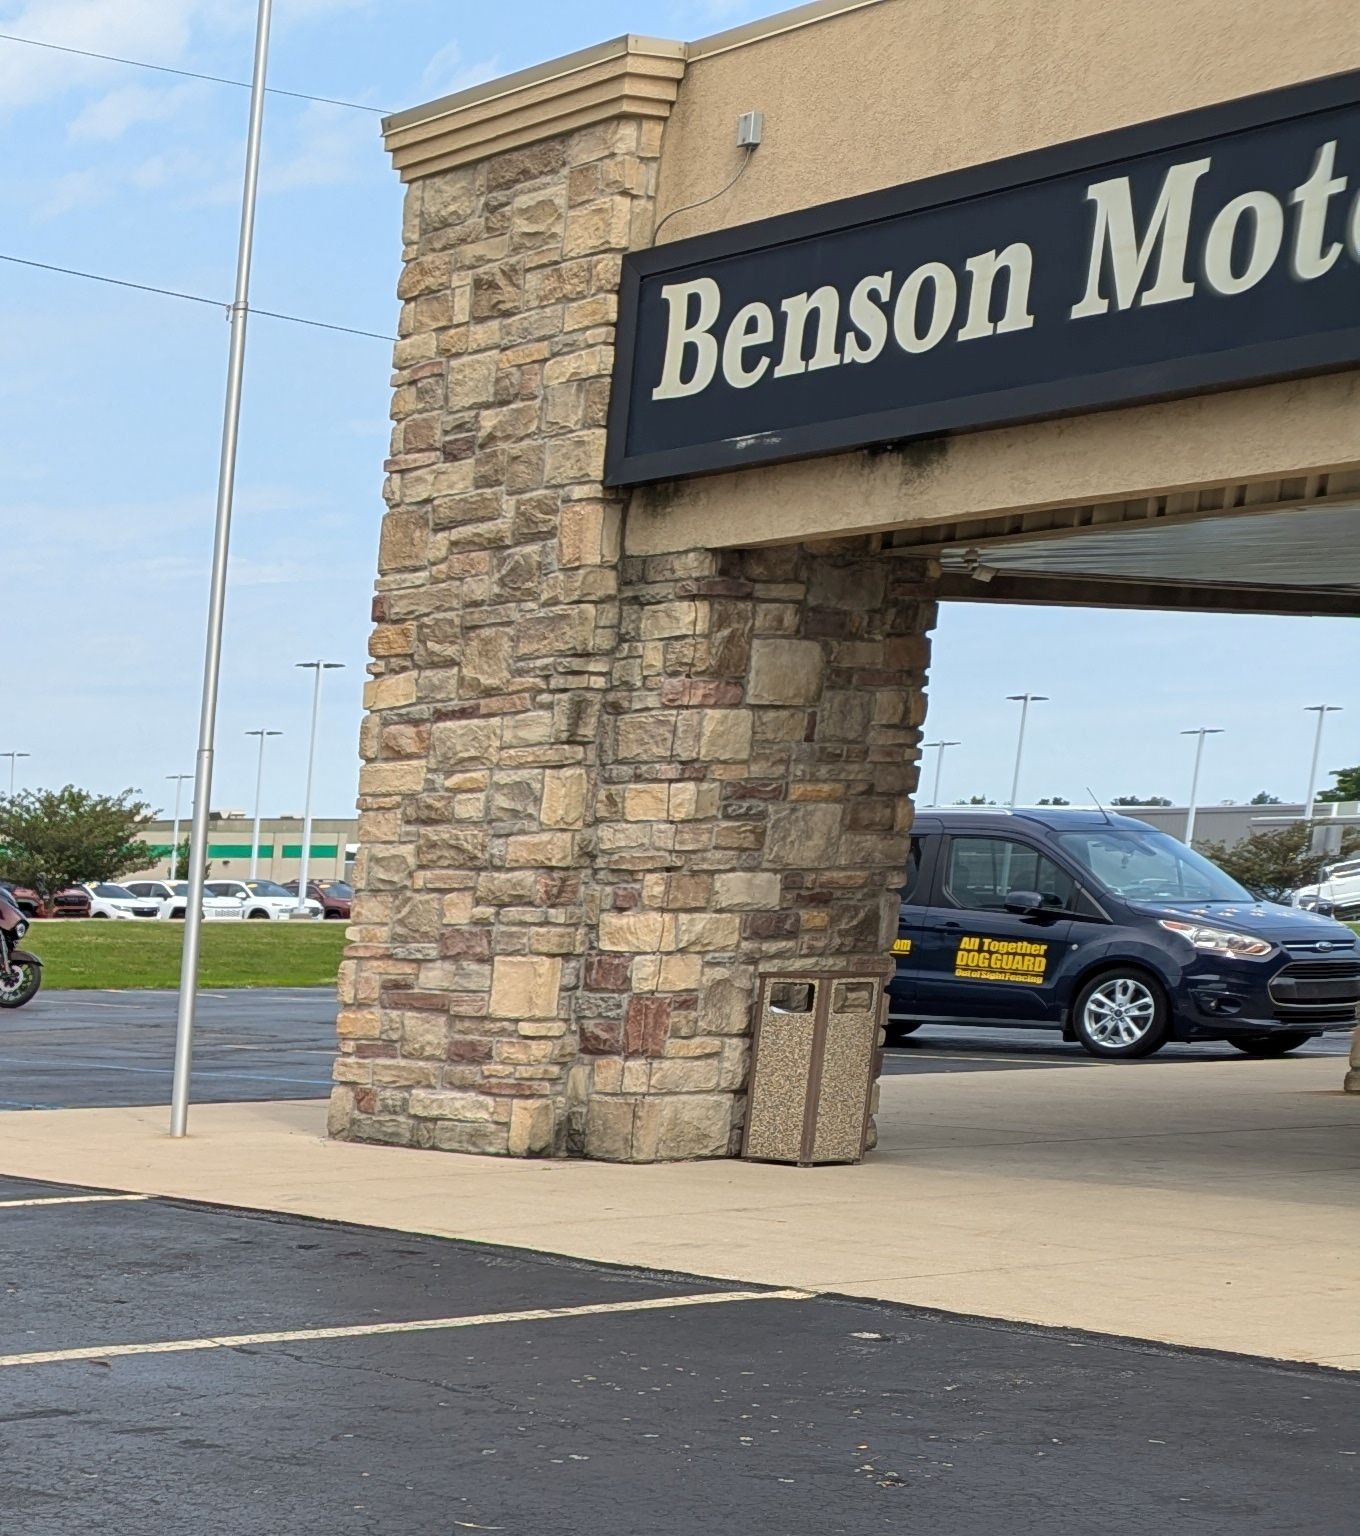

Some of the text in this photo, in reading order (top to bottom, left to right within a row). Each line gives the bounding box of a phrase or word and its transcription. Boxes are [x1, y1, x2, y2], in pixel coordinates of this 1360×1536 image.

[651, 139, 1360, 401] Benson Mot
[960, 937, 1048, 955] All Together
[956, 951, 1046, 972] DOG GUARD
